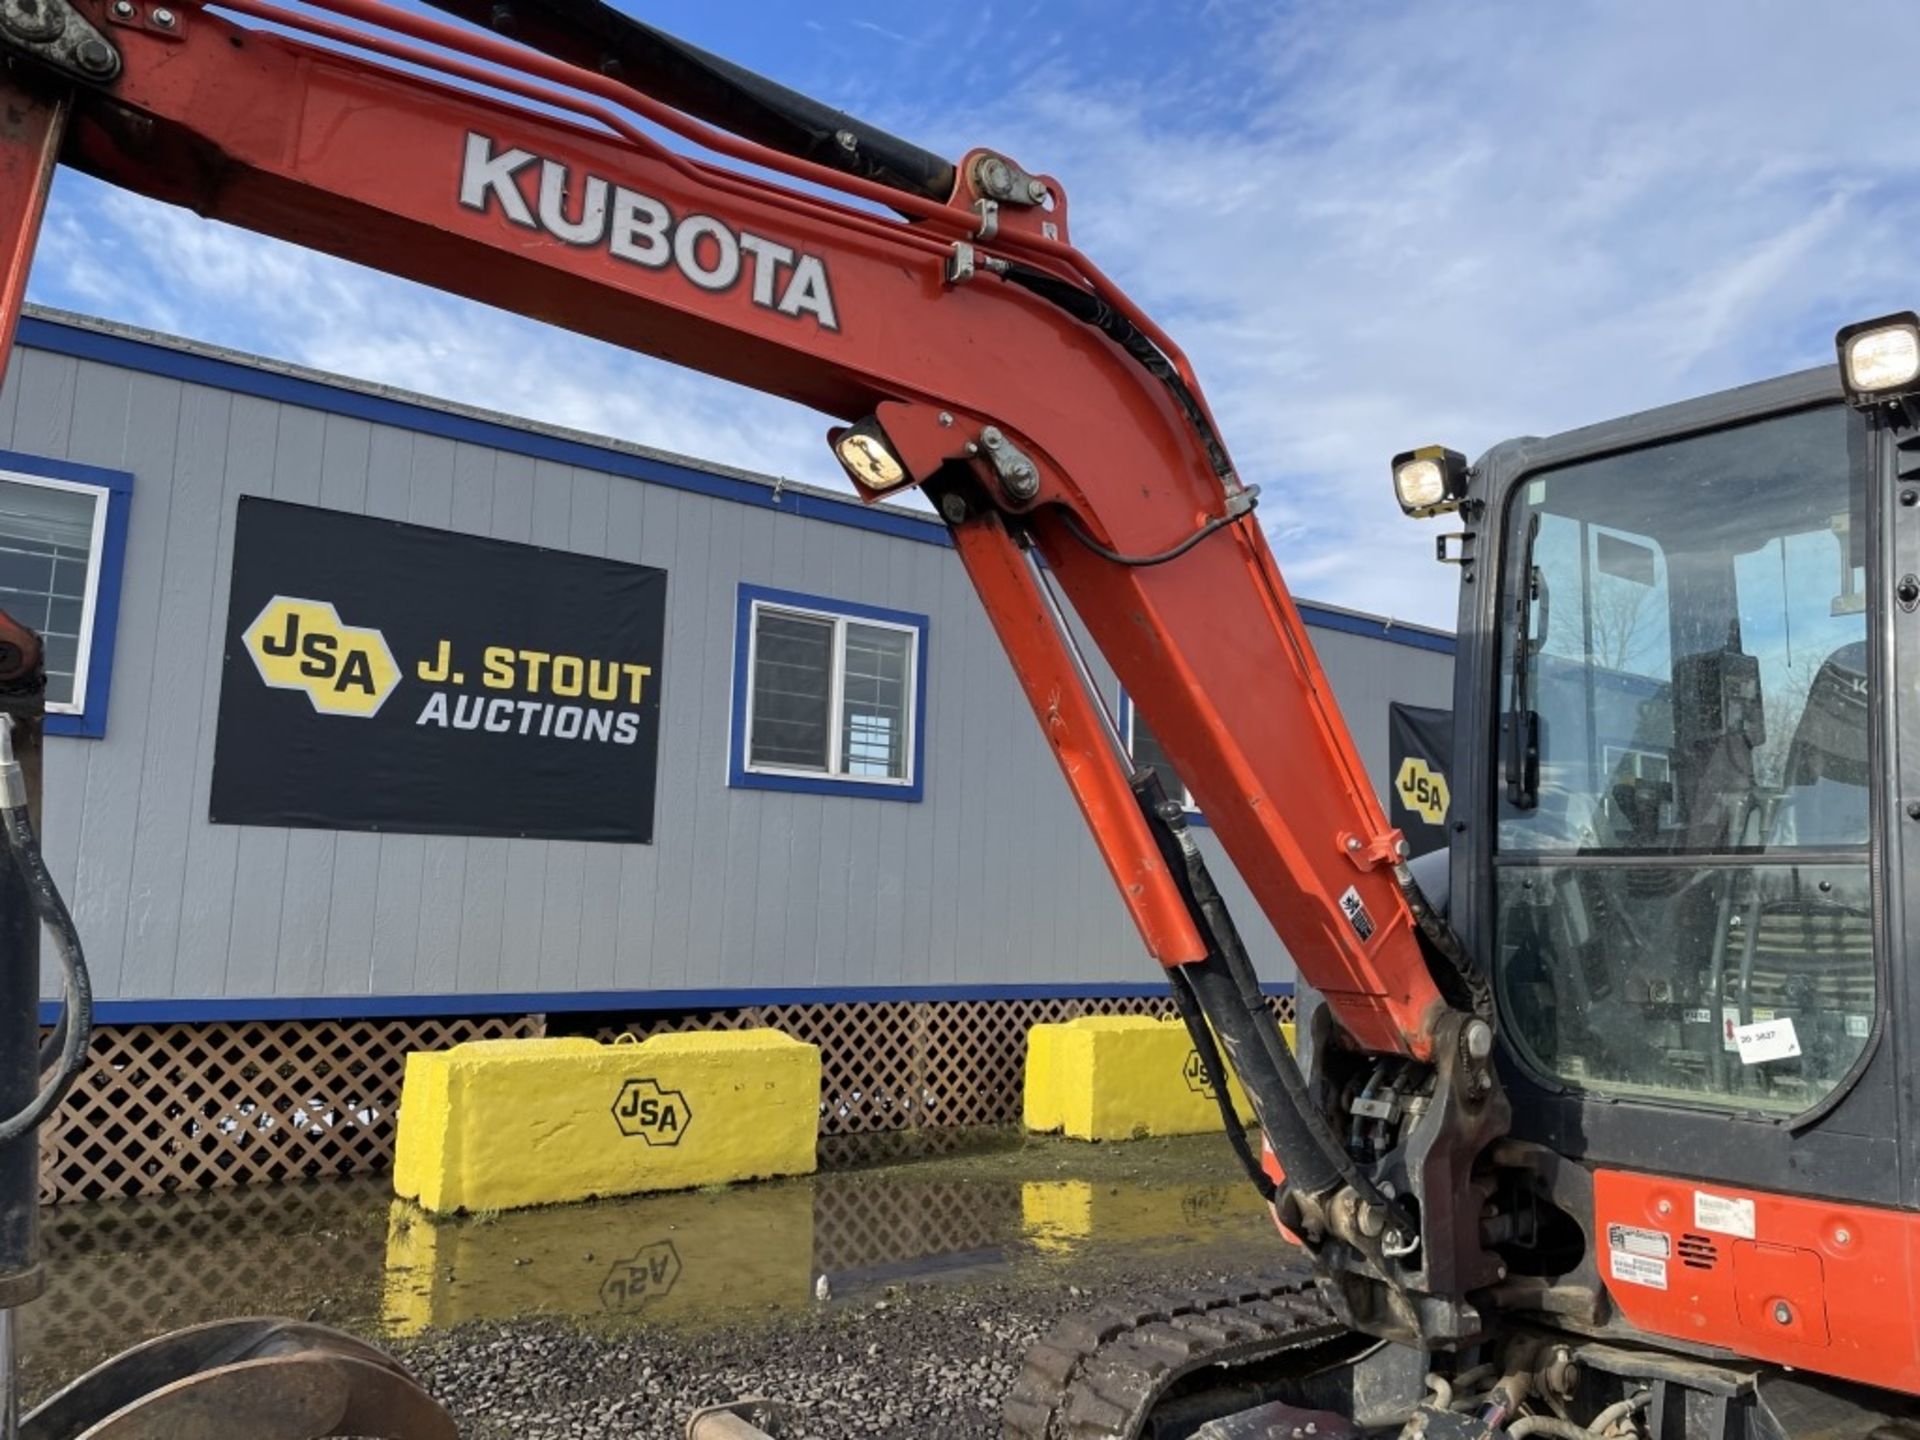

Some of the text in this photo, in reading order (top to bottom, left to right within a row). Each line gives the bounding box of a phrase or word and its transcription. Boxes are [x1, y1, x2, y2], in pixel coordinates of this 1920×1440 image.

[459, 131, 839, 331] KUBOTA
[262, 613, 377, 696] JSA
[417, 640, 651, 703] J. STOUT
[416, 691, 641, 745] AUCTIONS
[1403, 767, 1442, 811] JSA
[621, 1090, 677, 1131] JSA
